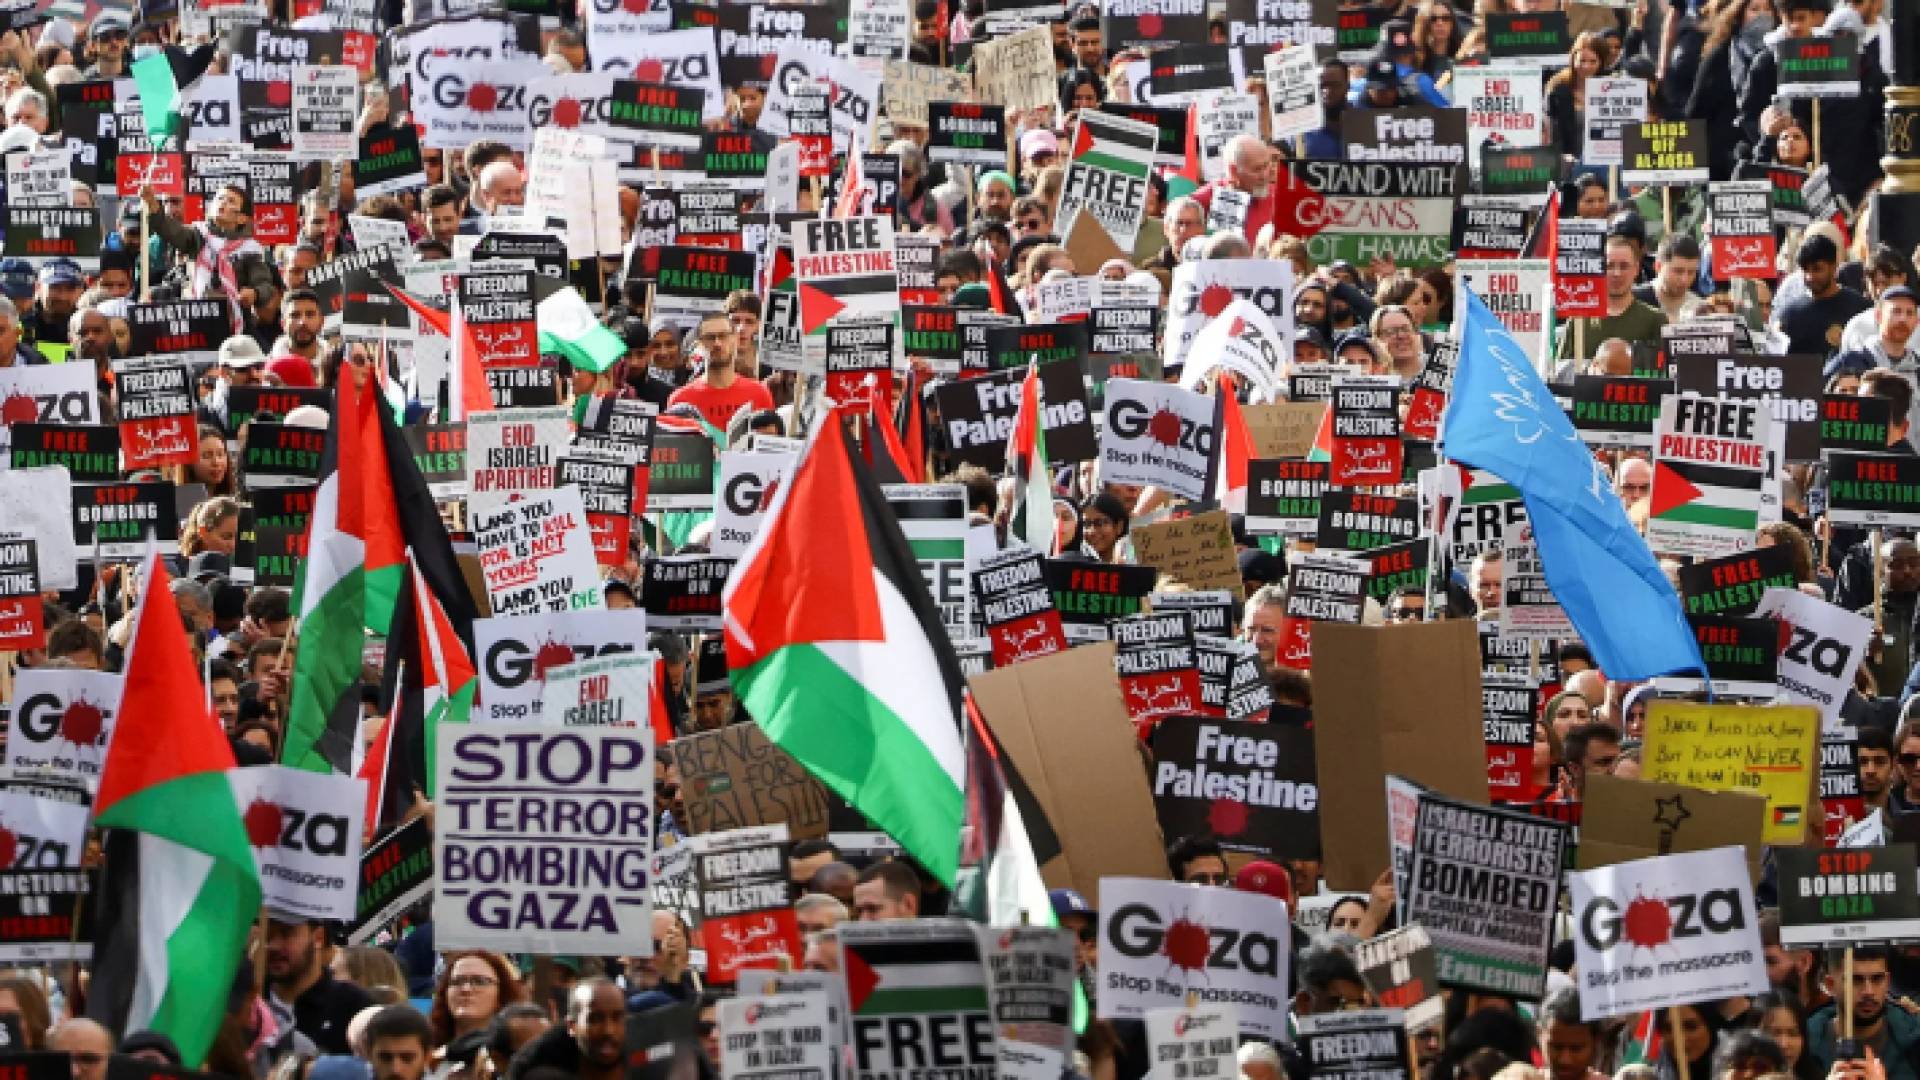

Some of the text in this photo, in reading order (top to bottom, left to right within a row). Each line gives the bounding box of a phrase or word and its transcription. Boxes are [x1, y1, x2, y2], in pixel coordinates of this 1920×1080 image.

[434, 74, 526, 112] Gz
[1484, 80, 1510, 95] END
[1376, 114, 1434, 140] Free
[1067, 166, 1143, 209] FREE
[1309, 165, 1384, 193] STAND
[1399, 164, 1456, 191] WITH
[1296, 200, 1420, 230] GAZANS,
[1716, 194, 1767, 211] FREEDOM
[1469, 211, 1523, 227] FREEDOM
[807, 219, 881, 252] FREE
[1358, 234, 1448, 263] HAMAS
[686, 254, 726, 272] FREE
[799, 252, 893, 276] PALESTINE
[466, 276, 528, 294] FREEDOM
[1488, 275, 1519, 294] END
[464, 303, 533, 320] PALESTINE
[1097, 309, 1151, 327] FREEDOM
[832, 328, 887, 346] FREEDOM
[1671, 337, 1729, 354] FREEDOM
[830, 351, 890, 369] PALESTINE
[124, 371, 183, 392] FREEDOM
[1717, 359, 1783, 389] Free
[2, 389, 92, 424] za
[1339, 390, 1391, 409] FREEDOM
[1604, 385, 1648, 403] FREE
[122, 397, 190, 418] PALESTINE
[1677, 399, 1757, 441] FREE
[502, 424, 535, 446] END
[1337, 416, 1397, 436] PALESTINE
[43, 432, 88, 450] FREE
[1660, 435, 1764, 468] PALESTINE
[487, 446, 550, 466] ISRAELI
[1279, 463, 1322, 479] STOP
[1857, 461, 1898, 481] FREE
[96, 487, 140, 504] STOP
[1351, 496, 1397, 512] STOP
[80, 503, 158, 521] BOMBING
[521, 500, 553, 520] YOU
[1332, 512, 1414, 536] BOMBING
[980, 561, 1040, 591] FREEDOM
[1072, 569, 1120, 590] FREE
[1296, 568, 1361, 595] FREEDOM
[1712, 558, 1761, 587] FREE
[538, 576, 573, 599] YOU
[984, 589, 1052, 617] PALESTINE
[1287, 597, 1358, 621] PALESTINE
[1112, 616, 1185, 643] FREEDOM
[1114, 647, 1193, 673] PALESTINE
[580, 675, 609, 700] END
[1197, 726, 1278, 766] Free
[451, 733, 644, 785] STOP
[1154, 762, 1318, 810] Palestine
[243, 799, 349, 857] za
[446, 798, 649, 837] TERROR
[1503, 820, 1558, 849] STATE
[704, 847, 782, 880] FREEDOM
[1425, 829, 1556, 875] TERRORISTS
[1818, 852, 1872, 873] STOP
[444, 845, 648, 889] BOMBING
[1420, 858, 1547, 912] BOMBED
[1799, 872, 1897, 897] BOMBING
[466, 890, 619, 934] GAZA
[1821, 896, 1874, 917] GAZA
[1581, 887, 1746, 953] Gza
[1108, 903, 1278, 978] Gza
[1657, 948, 1754, 974] massacre
[1108, 972, 1152, 993] Stop
[854, 1014, 994, 1070] FREE
